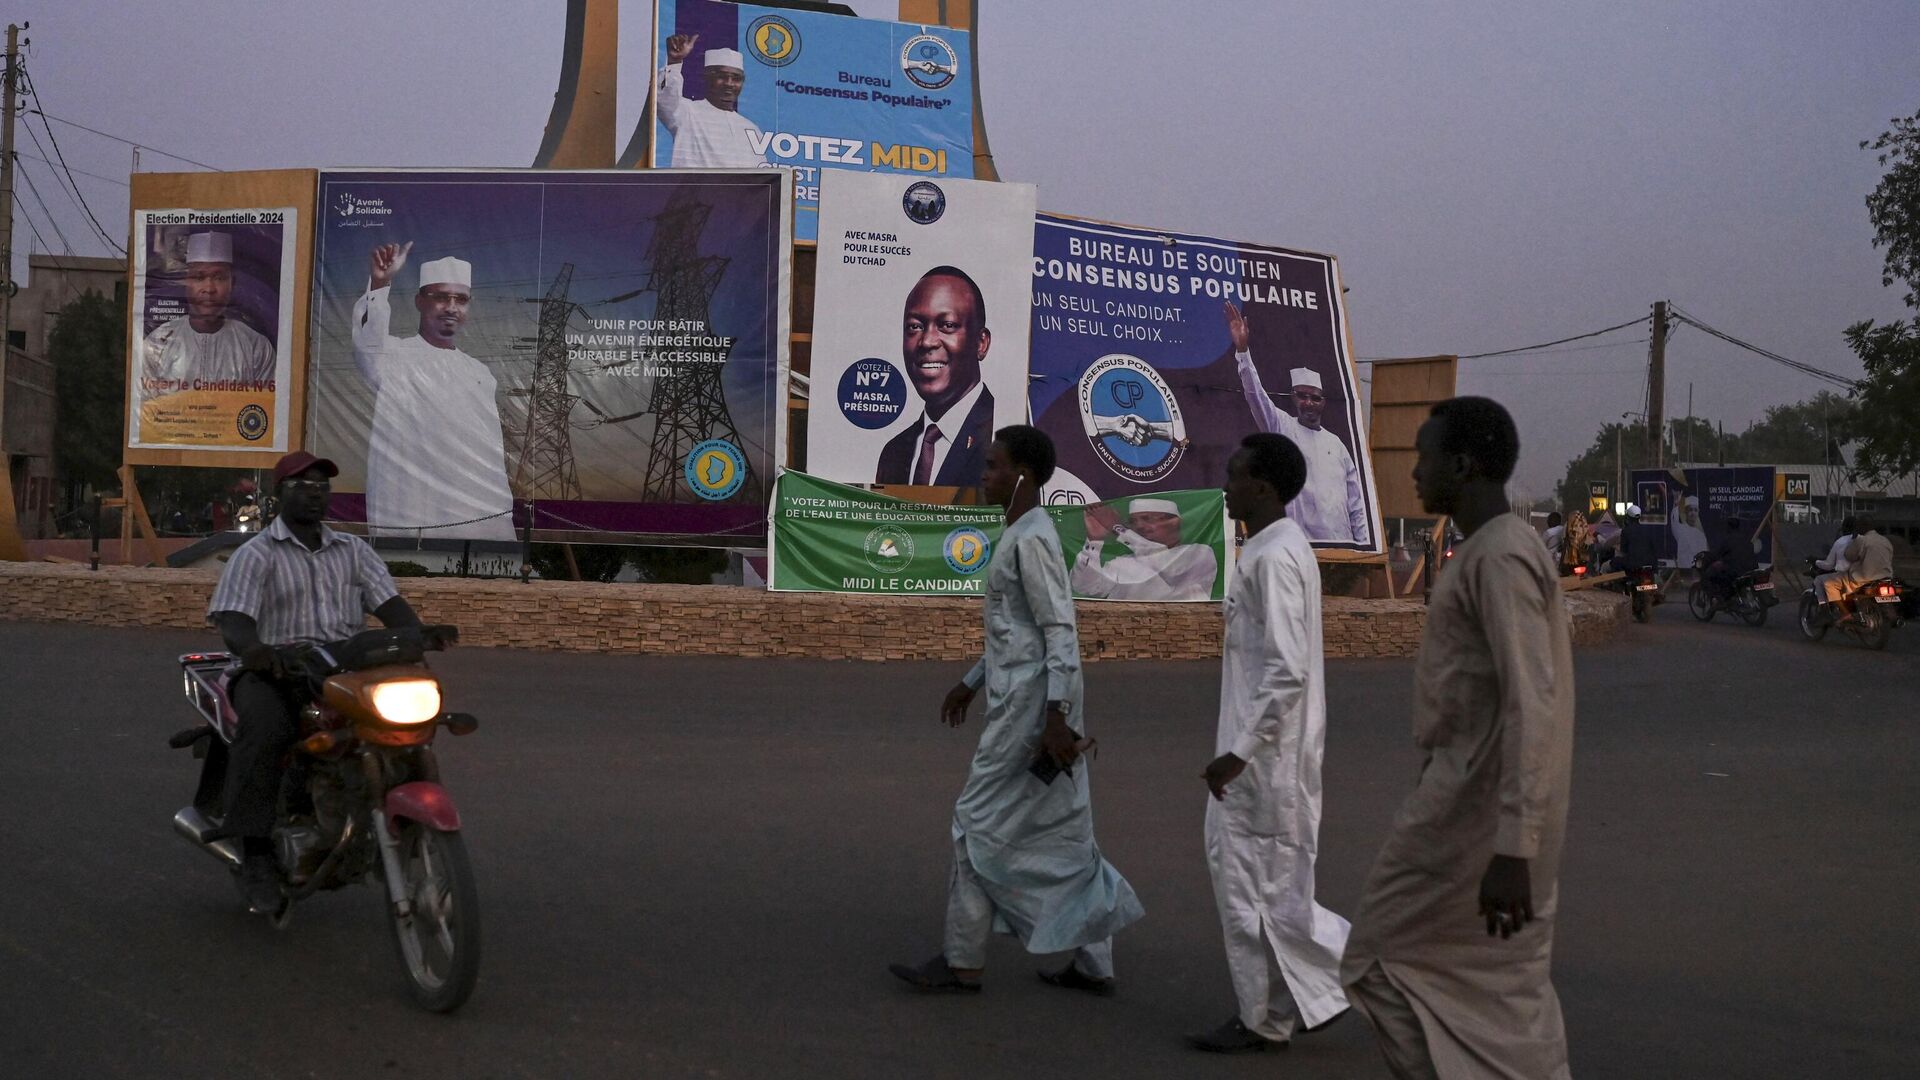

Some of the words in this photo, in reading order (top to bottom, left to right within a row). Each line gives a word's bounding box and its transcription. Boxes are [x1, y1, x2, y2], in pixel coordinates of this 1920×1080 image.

[838, 71, 892, 88] Bureau
[744, 129, 864, 165] VOTEZ
[871, 140, 947, 174] MIDI
[356, 198, 384, 206] Avenir
[146, 213, 186, 224] Election
[188, 213, 257, 224] Présidentielle
[259, 212, 284, 224] 2024
[355, 207, 393, 215] Solidaire
[844, 230, 867, 240] AVEC
[867, 232, 898, 242] MASRA
[844, 242, 868, 252] POUR
[869, 244, 878, 254] LE
[843, 255, 856, 264] DU
[857, 256, 886, 267] TCHAD
[1069, 237, 1153, 267] BUREAU
[1163, 250, 1189, 270] DE
[1196, 253, 1281, 281] SOUTIEN
[1032, 257, 1180, 296] CONSENSUS
[1190, 276, 1318, 310] POPULAIRE
[1032, 291, 1052, 308] UN
[1059, 295, 1100, 314] SEUL
[629, 320, 665, 331] POUR
[669, 318, 705, 332] BÂTIR
[1040, 314, 1061, 332] UN
[1068, 318, 1108, 337] SEUL
[1113, 323, 1163, 343] CHOIX
[564, 334, 584, 345] UN
[587, 334, 635, 346] AVENIR
[639, 333, 731, 348] ÉNERGÉTIQUE
[568, 350, 627, 361] DURABLE
[631, 351, 646, 361] ET
[650, 352, 727, 363] ACCESSIBLE
[606, 366, 639, 377] AVEC
[857, 363, 882, 371] VOTEZ
[178, 379, 189, 391] le
[193, 378, 249, 393] Candidat
[1081, 358, 1125, 414] CONSENSUS
[1127, 359, 1180, 421] POPULAIRE
[853, 392, 891, 402] MASRA
[1111, 380, 1144, 409] CP
[844, 401, 899, 413] PRÉSIDENT
[689, 446, 705, 470] COALITION
[1097, 442, 1116, 466] UNITE
[1120, 466, 1155, 477] VOLONTE
[1157, 446, 1179, 473] SUCCES
[1592, 486, 1606, 495] CAT
[1787, 479, 1809, 495] CAT
[791, 497, 826, 507] VOTEZ
[828, 499, 850, 508] MIDI
[852, 501, 881, 510] POUR
[883, 502, 897, 510] LA
[785, 509, 800, 518] DE
[803, 510, 833, 519] L'EAU
[836, 511, 849, 519] ET
[851, 512, 872, 520] UNE
[875, 512, 934, 521] ÉDUCATION
[936, 514, 951, 522] DE
[953, 514, 997, 523] QUALITÉ
[842, 577, 875, 589] MIDI
[880, 578, 899, 590] LE
[903, 578, 982, 591] CANDIDAT
